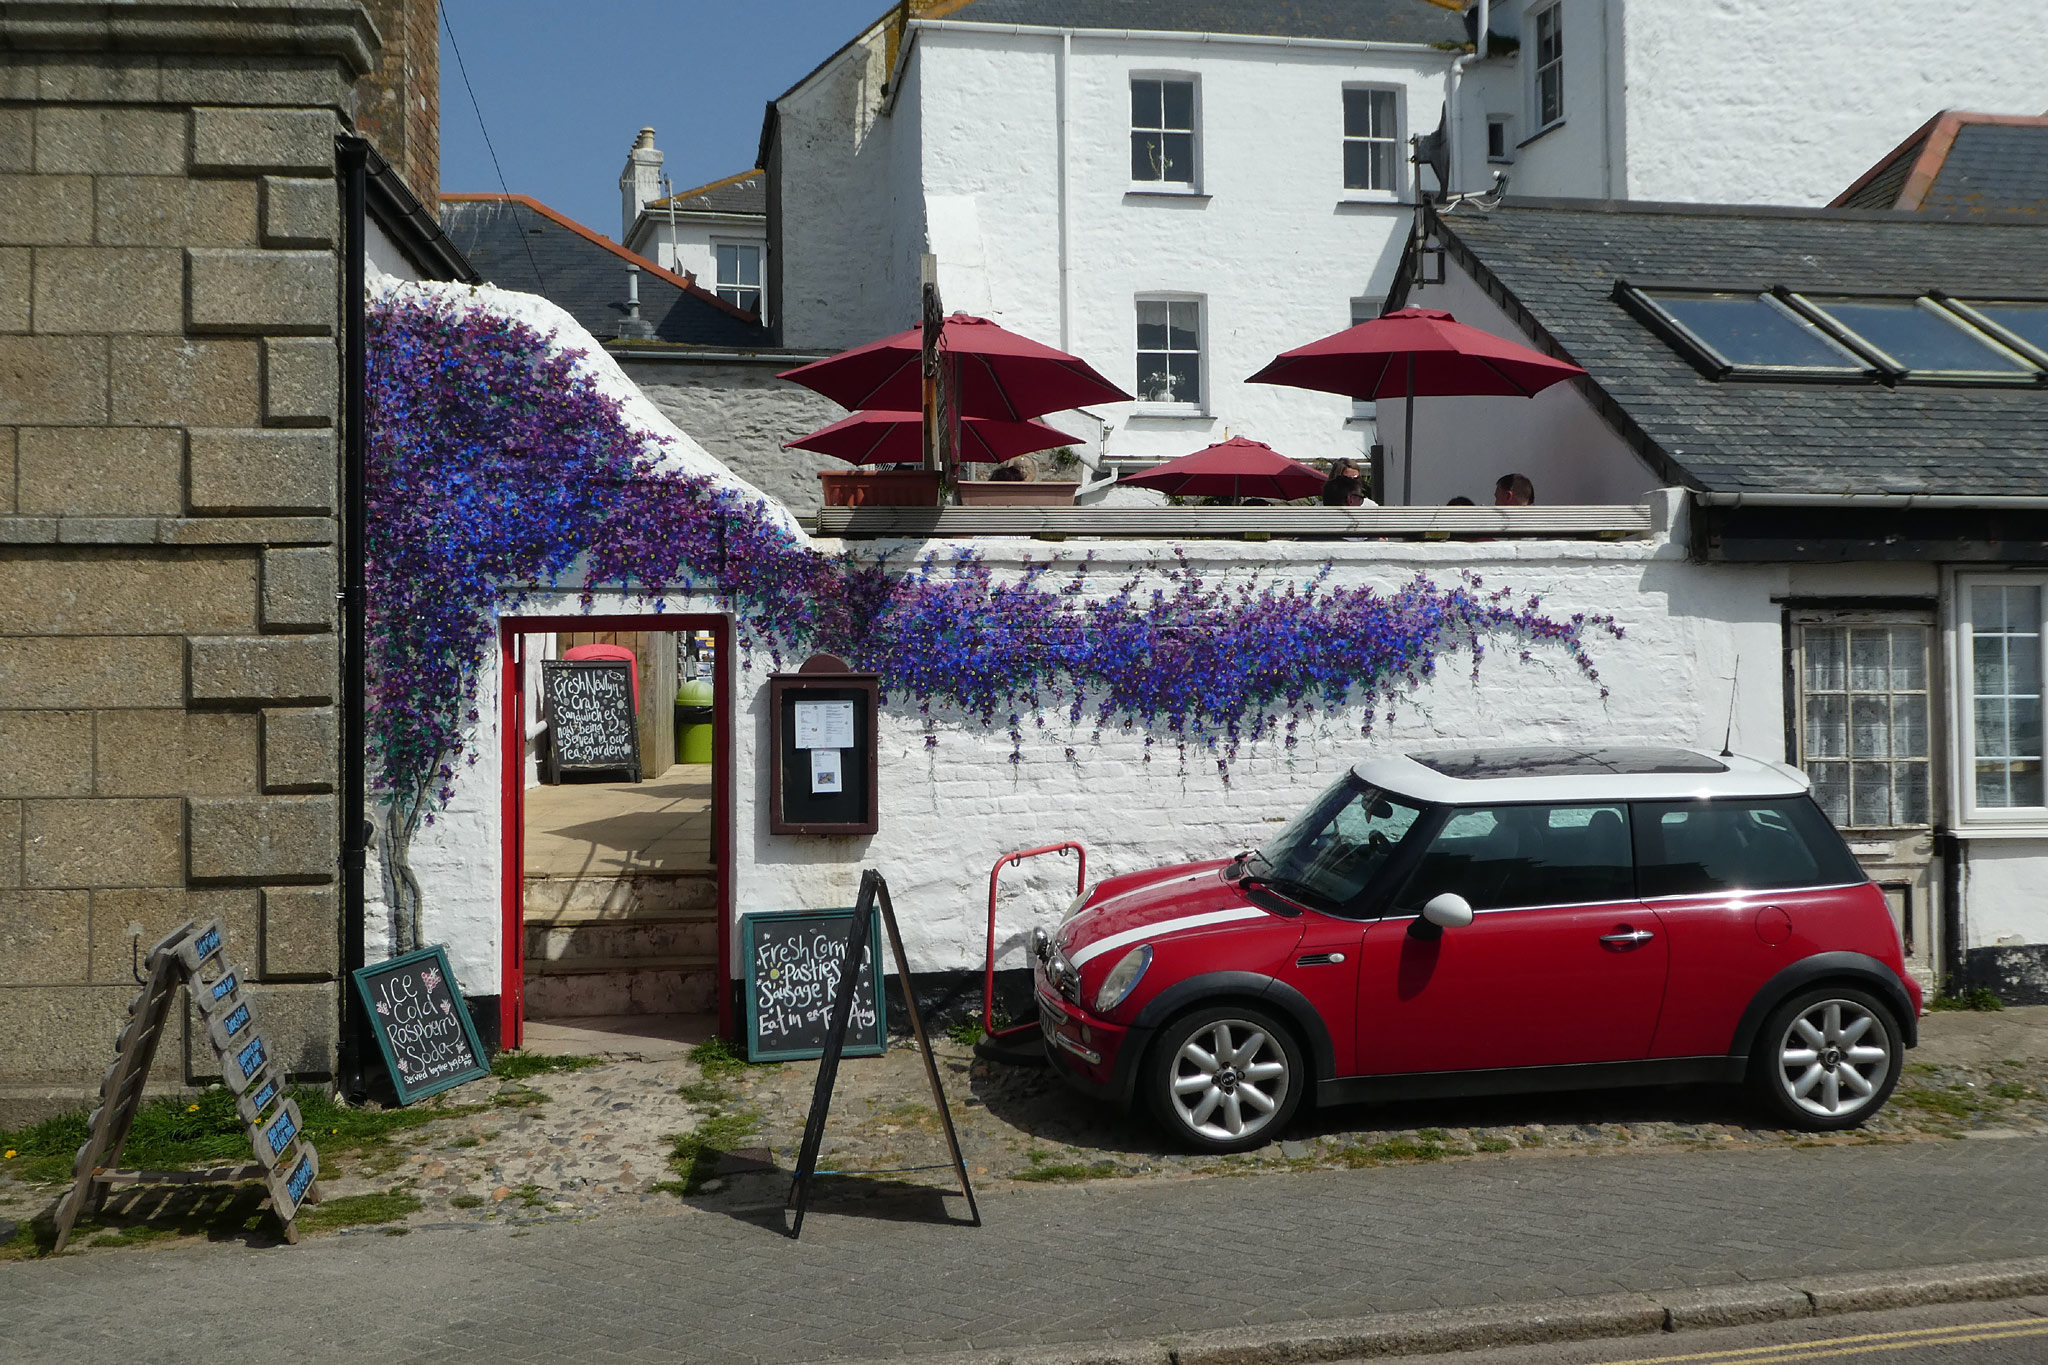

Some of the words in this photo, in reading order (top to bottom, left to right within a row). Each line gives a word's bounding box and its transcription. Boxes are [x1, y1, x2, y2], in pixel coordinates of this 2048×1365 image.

[554, 672, 586, 703] Fresh
[571, 694, 600, 710] Crab
[557, 707, 619, 731] Sandwiches
[557, 721, 574, 739] now
[579, 722, 607, 744] being
[560, 744, 581, 760] Tea
[585, 742, 625, 760] garden
[609, 732, 629, 745] our
[759, 935, 810, 969] Fresh
[759, 981, 822, 1008] Sausage
[760, 1005, 789, 1036] Eat
[788, 1008, 802, 1028] in
[386, 1012, 461, 1058] Raspberry
[406, 1040, 454, 1073] Soda
